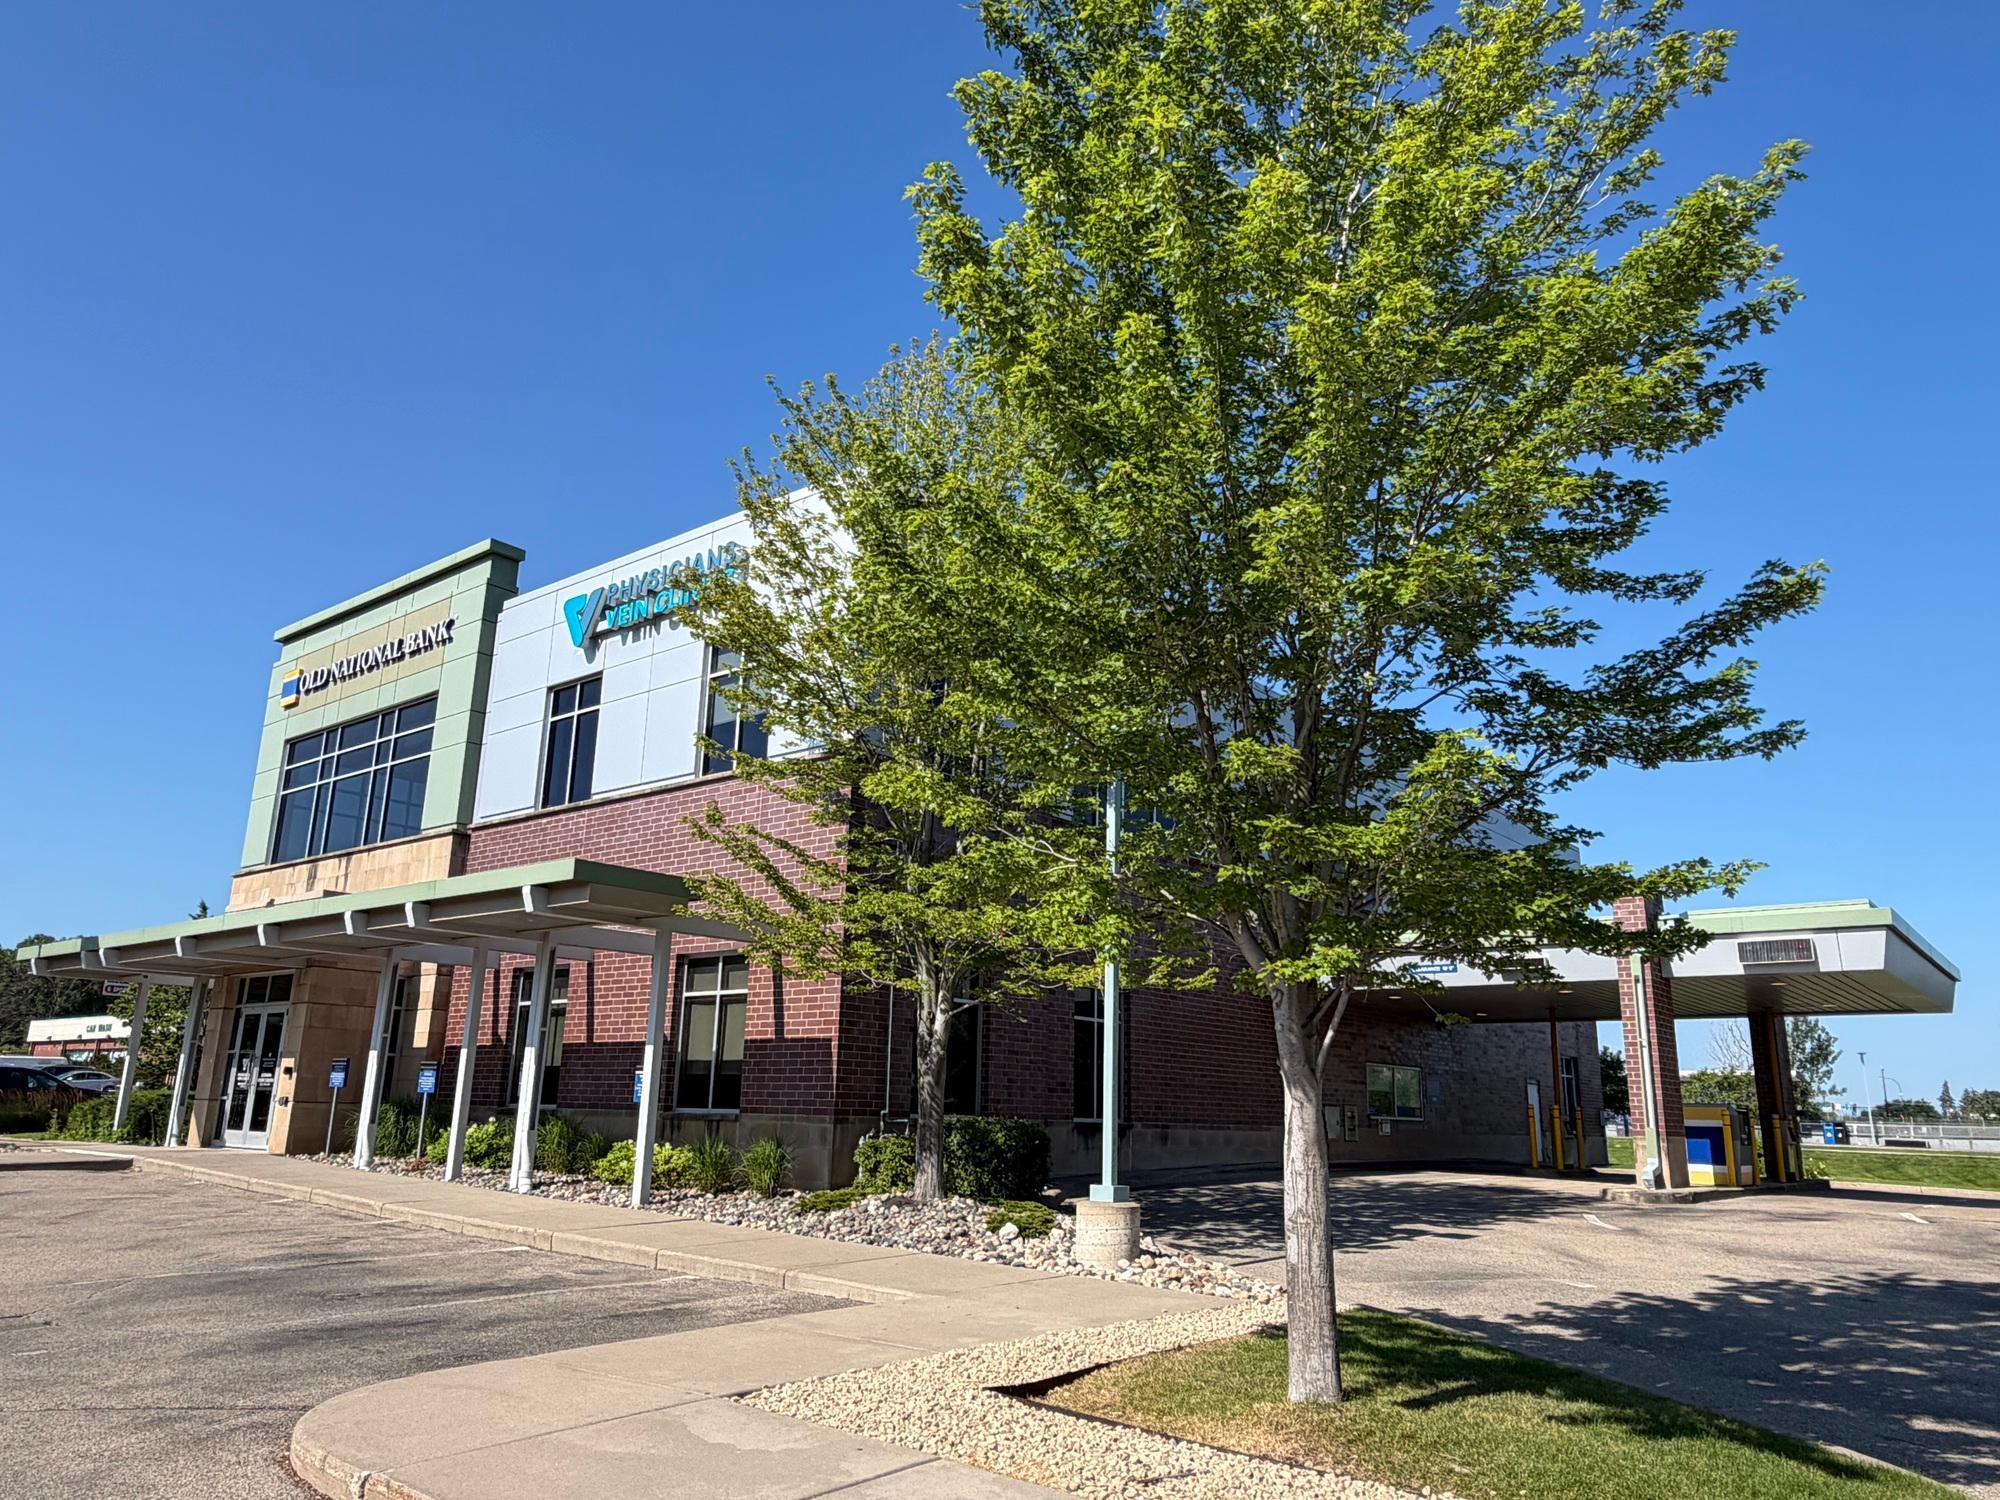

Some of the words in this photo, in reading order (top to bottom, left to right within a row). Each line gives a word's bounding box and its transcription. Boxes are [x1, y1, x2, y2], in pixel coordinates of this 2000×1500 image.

[607, 541, 738, 601] PHYSICIANS
[606, 598, 650, 628] VEIN
[299, 666, 329, 693] OLD
[330, 638, 402, 682] NATIONAL
[404, 619, 455, 653] BANK
